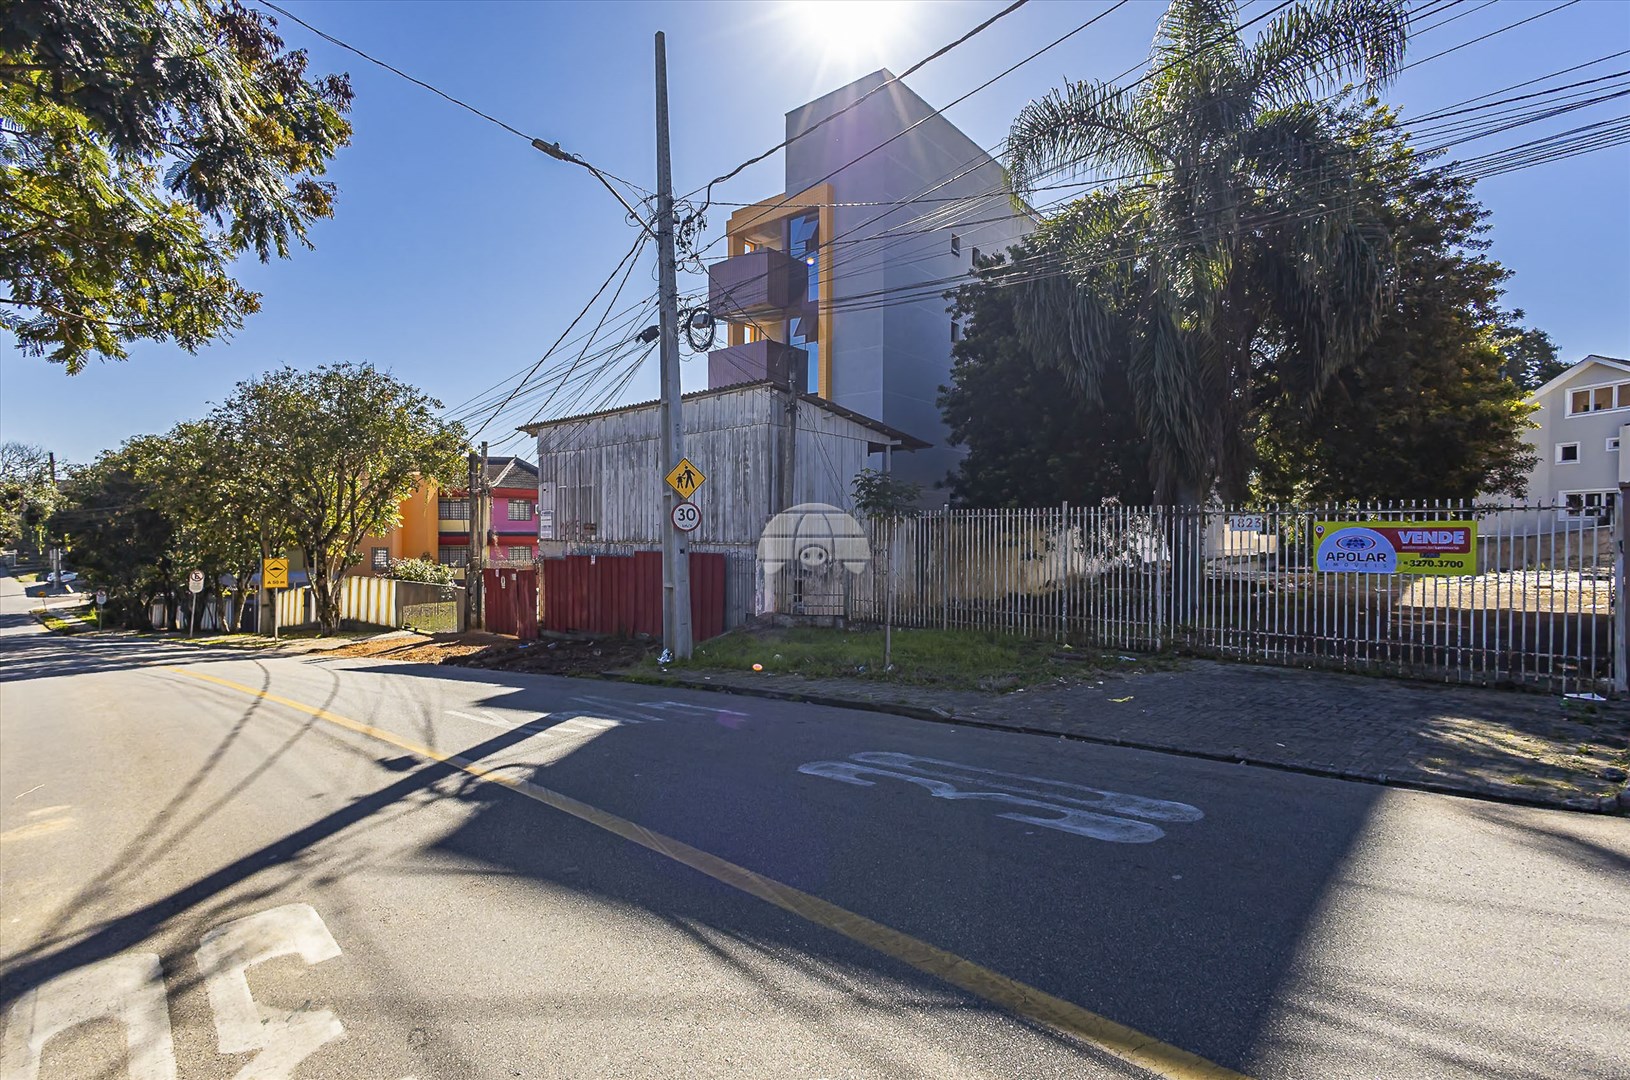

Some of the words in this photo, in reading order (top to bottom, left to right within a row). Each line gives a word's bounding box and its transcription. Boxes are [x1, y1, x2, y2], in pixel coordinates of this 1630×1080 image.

[678, 508, 696, 521] 30
[1229, 517, 1261, 528] 1823
[1397, 530, 1465, 545] VENDE
[1326, 552, 1387, 562] APOLAR
